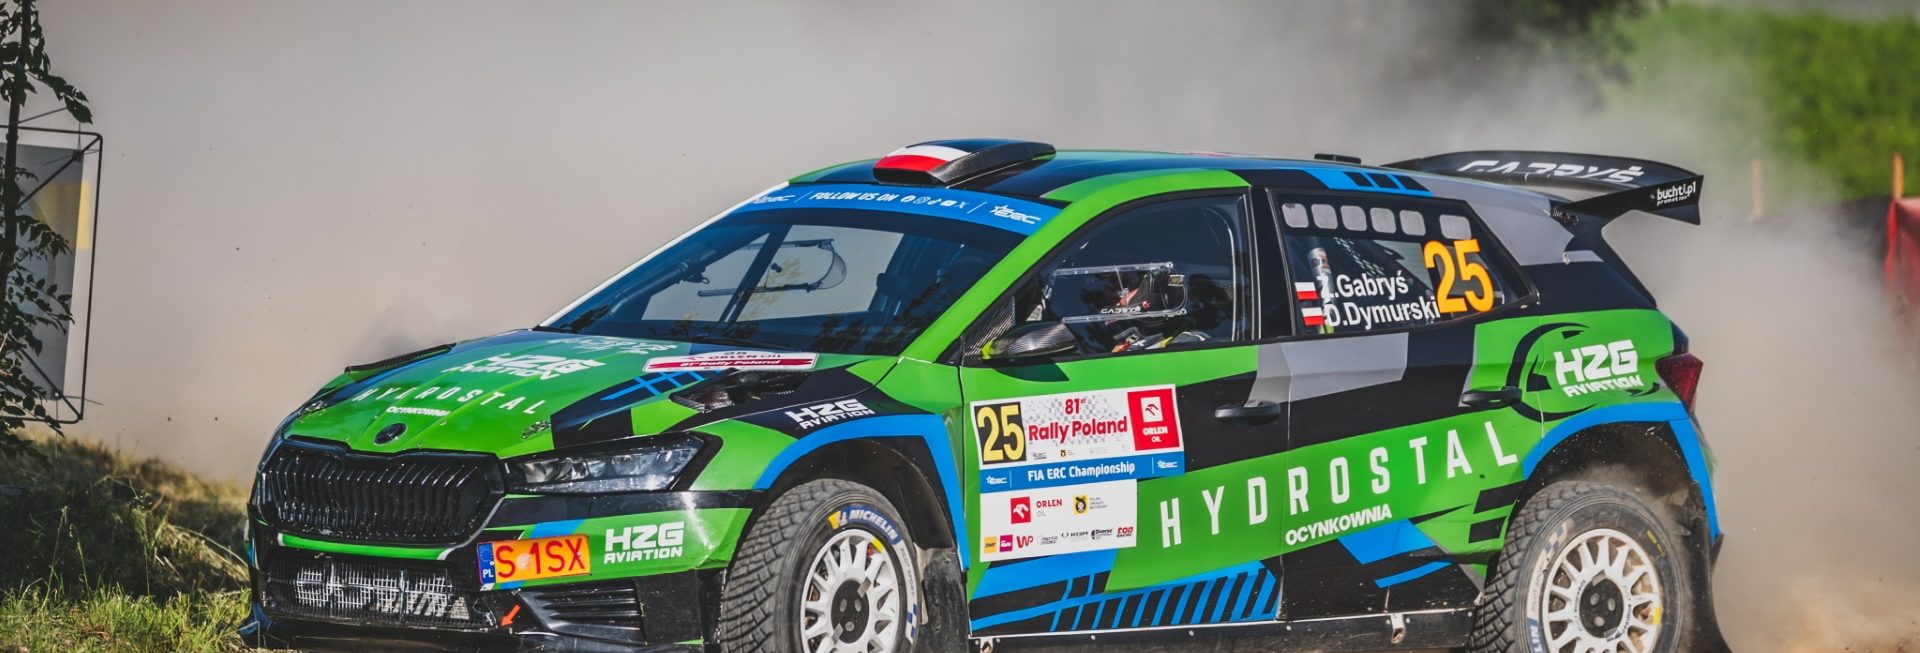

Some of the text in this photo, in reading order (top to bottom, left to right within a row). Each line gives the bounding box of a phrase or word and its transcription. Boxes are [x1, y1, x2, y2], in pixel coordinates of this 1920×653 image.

[809, 191, 899, 201] FOLLOW US ON
[1657, 180, 1696, 200] buchti.pl
[1317, 270, 1409, 302] Z.Gabryś
[1423, 239, 1494, 314] 25
[1324, 296, 1441, 331] D.Dymurski
[1553, 339, 1639, 386] HZG
[1562, 374, 1645, 398] AVIATION
[352, 386, 546, 415] HYDROSTAL
[784, 398, 869, 423] HZG
[799, 409, 876, 430] AVIATION
[977, 404, 1026, 463] 25
[1028, 416, 1128, 444] Rally Poland
[1142, 426, 1168, 435] ORLEN
[1027, 461, 1136, 482] FIA ERC Championship
[1159, 421, 1518, 549] HYDROSTAL
[1036, 499, 1063, 508] ORLEN
[604, 521, 685, 552] HZG
[849, 509, 899, 541] MICHELIN
[1285, 503, 1392, 546] OCYNKOWNIA
[496, 537, 586, 579] S 1SX
[603, 546, 683, 565] AVIATION
[482, 568, 494, 579] PL
